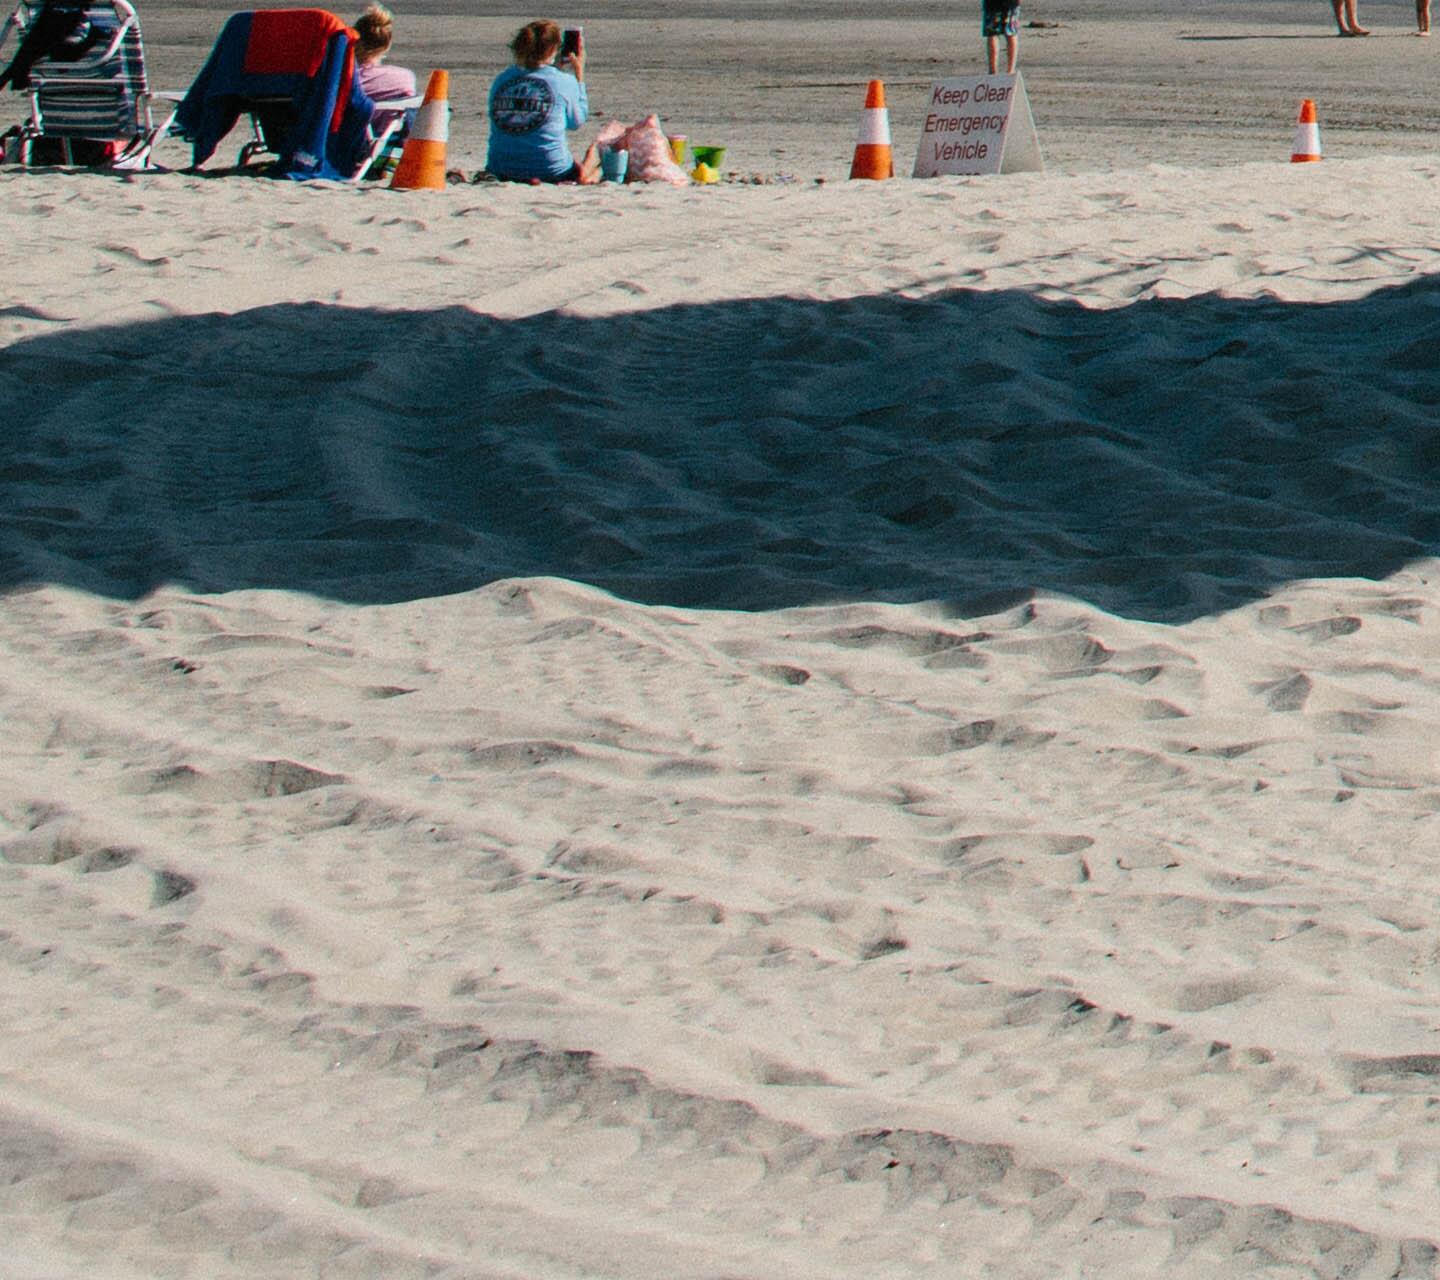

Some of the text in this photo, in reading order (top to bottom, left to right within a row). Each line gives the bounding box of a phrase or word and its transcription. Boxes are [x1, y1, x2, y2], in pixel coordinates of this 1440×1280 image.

[932, 84, 1012, 108] Keep Clear
[924, 114, 1009, 135] Emergency
[934, 140, 988, 161] Vehicle
